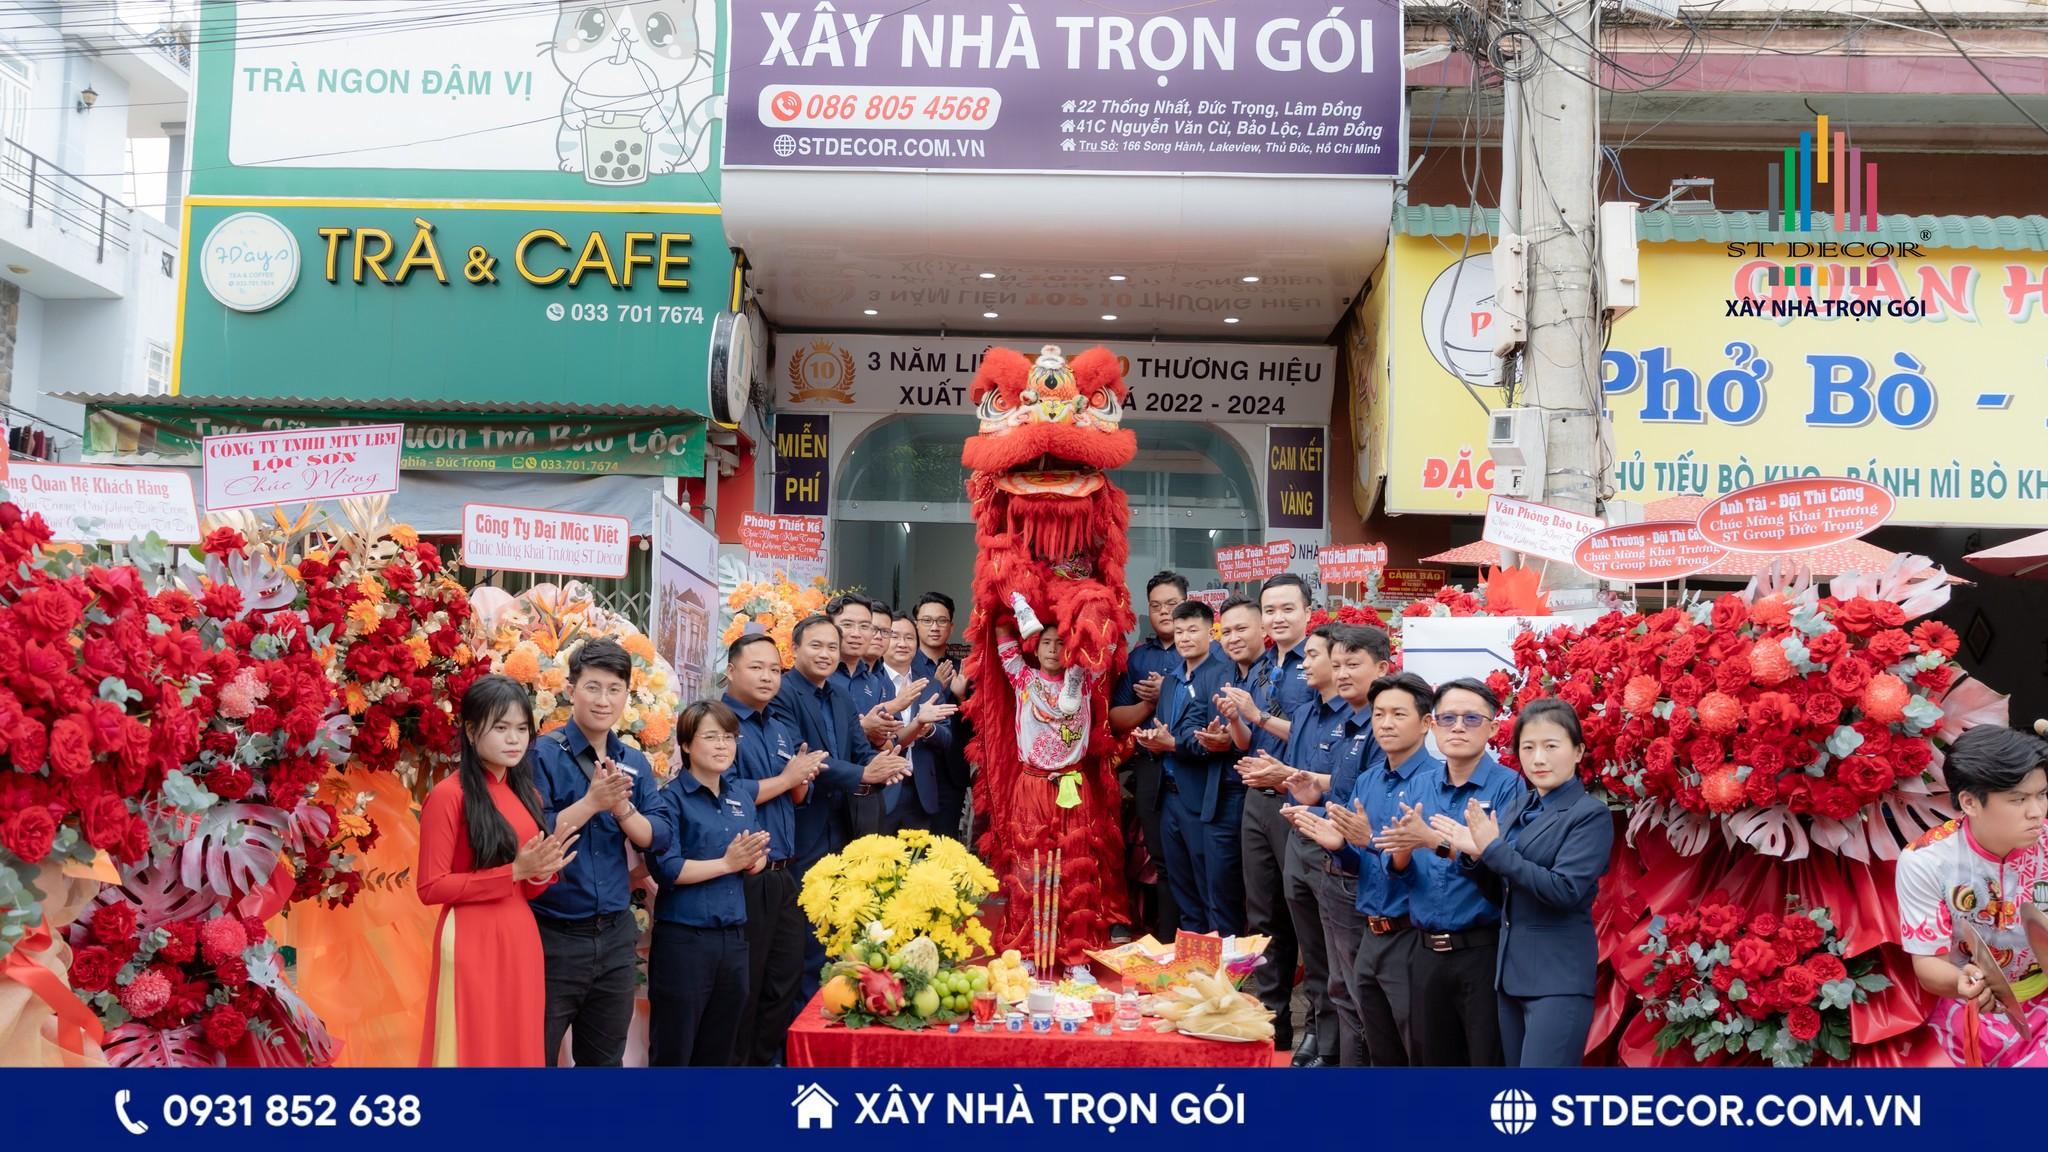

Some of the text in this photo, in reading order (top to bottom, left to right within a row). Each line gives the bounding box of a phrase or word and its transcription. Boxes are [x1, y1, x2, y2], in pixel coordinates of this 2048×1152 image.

[760, 1, 1374, 87] XÂY NHÀ TRỌN GÓI
[243, 61, 532, 101] TRÀ NGON ĐẬM VỊ
[806, 94, 990, 122] 086 805 4568
[1077, 98, 1362, 120] 22 Thống Nhất, Đức Trọng, Lâm Đồng
[1076, 118, 1383, 140] 41C Nguyễn Văn Cừ, Bảo Lộc, Lâm Đồng
[798, 137, 985, 157] STDECOR.COM.VN
[1122, 141, 1141, 151] 166
[1143, 141, 1172, 153] Song
[1174, 141, 1206, 153] Hành,
[1209, 142, 1262, 154] Lakeview,
[1265, 141, 1287, 153] Thủ
[1289, 142, 1313, 155] Đức,
[1316, 141, 1331, 154] Hồ
[1334, 143, 1352, 154] Chí
[1355, 143, 1381, 155] Minh
[318, 216, 692, 289] TRÀ & CAFE
[571, 304, 704, 324] 033 701 7674
[809, 361, 836, 380] 10
[867, 351, 881, 371] 3
[890, 347, 946, 373] NĂM
[956, 345, 994, 373] LI
[1137, 357, 1249, 380] THƯƠNG
[1259, 357, 1322, 387] HIỆU
[899, 378, 966, 406] XUẤT
[1145, 392, 1203, 413] 2022
[1228, 395, 1286, 415] 2024
[1805, 352, 1935, 427] Bò
[210, 432, 397, 459] CÔNG TY TNHH MTV LBM
[479, 424, 535, 450] trà
[549, 424, 614, 452] Bảo
[627, 428, 688, 460] Lộc
[778, 423, 827, 458] MIỄN
[1271, 437, 1322, 472] CAM KẾT
[253, 452, 357, 473] LỘC SƠN
[400, 457, 427, 469] ghĩa
[436, 457, 459, 468] Đức
[540, 459, 618, 472] 033.701.7674
[1424, 450, 1495, 498] ĐẶC
[1654, 450, 1708, 493] TIẾU
[1718, 455, 1754, 493] BÒ
[1930, 459, 1960, 498] MÌ
[1971, 460, 2007, 499] BÒ
[32, 474, 169, 499] Quan Hệ Khách Hàng
[224, 475, 292, 496] Chúc
[785, 472, 821, 502] PHÍ
[1280, 485, 1313, 516] VÀNG
[1719, 486, 1864, 516] Anh Tài Đội Thi Công
[744, 515, 776, 531] Phòng
[779, 518, 805, 532] Thiết
[1495, 501, 1514, 514] Văn
[1517, 506, 1551, 526] Phòng
[1552, 514, 1572, 529] Bảo
[1710, 503, 1879, 532] Chúc Mừng Khai Trương
[476, 513, 619, 548] Công Ty Đại Mộc Việt
[1591, 537, 1609, 549] Anh
[1653, 530, 1668, 546] Đội
[1669, 529, 1686, 542] Thi
[1723, 519, 1865, 543] ST Group Đức Trọng
[468, 539, 491, 555] Chúc
[524, 544, 544, 560] Khai
[581, 549, 595, 563] ST
[597, 550, 625, 566] Decor
[1583, 543, 1720, 562] Chúc Mừng Khai Trương
[1593, 555, 1709, 572] ST Group Đức Trọng
